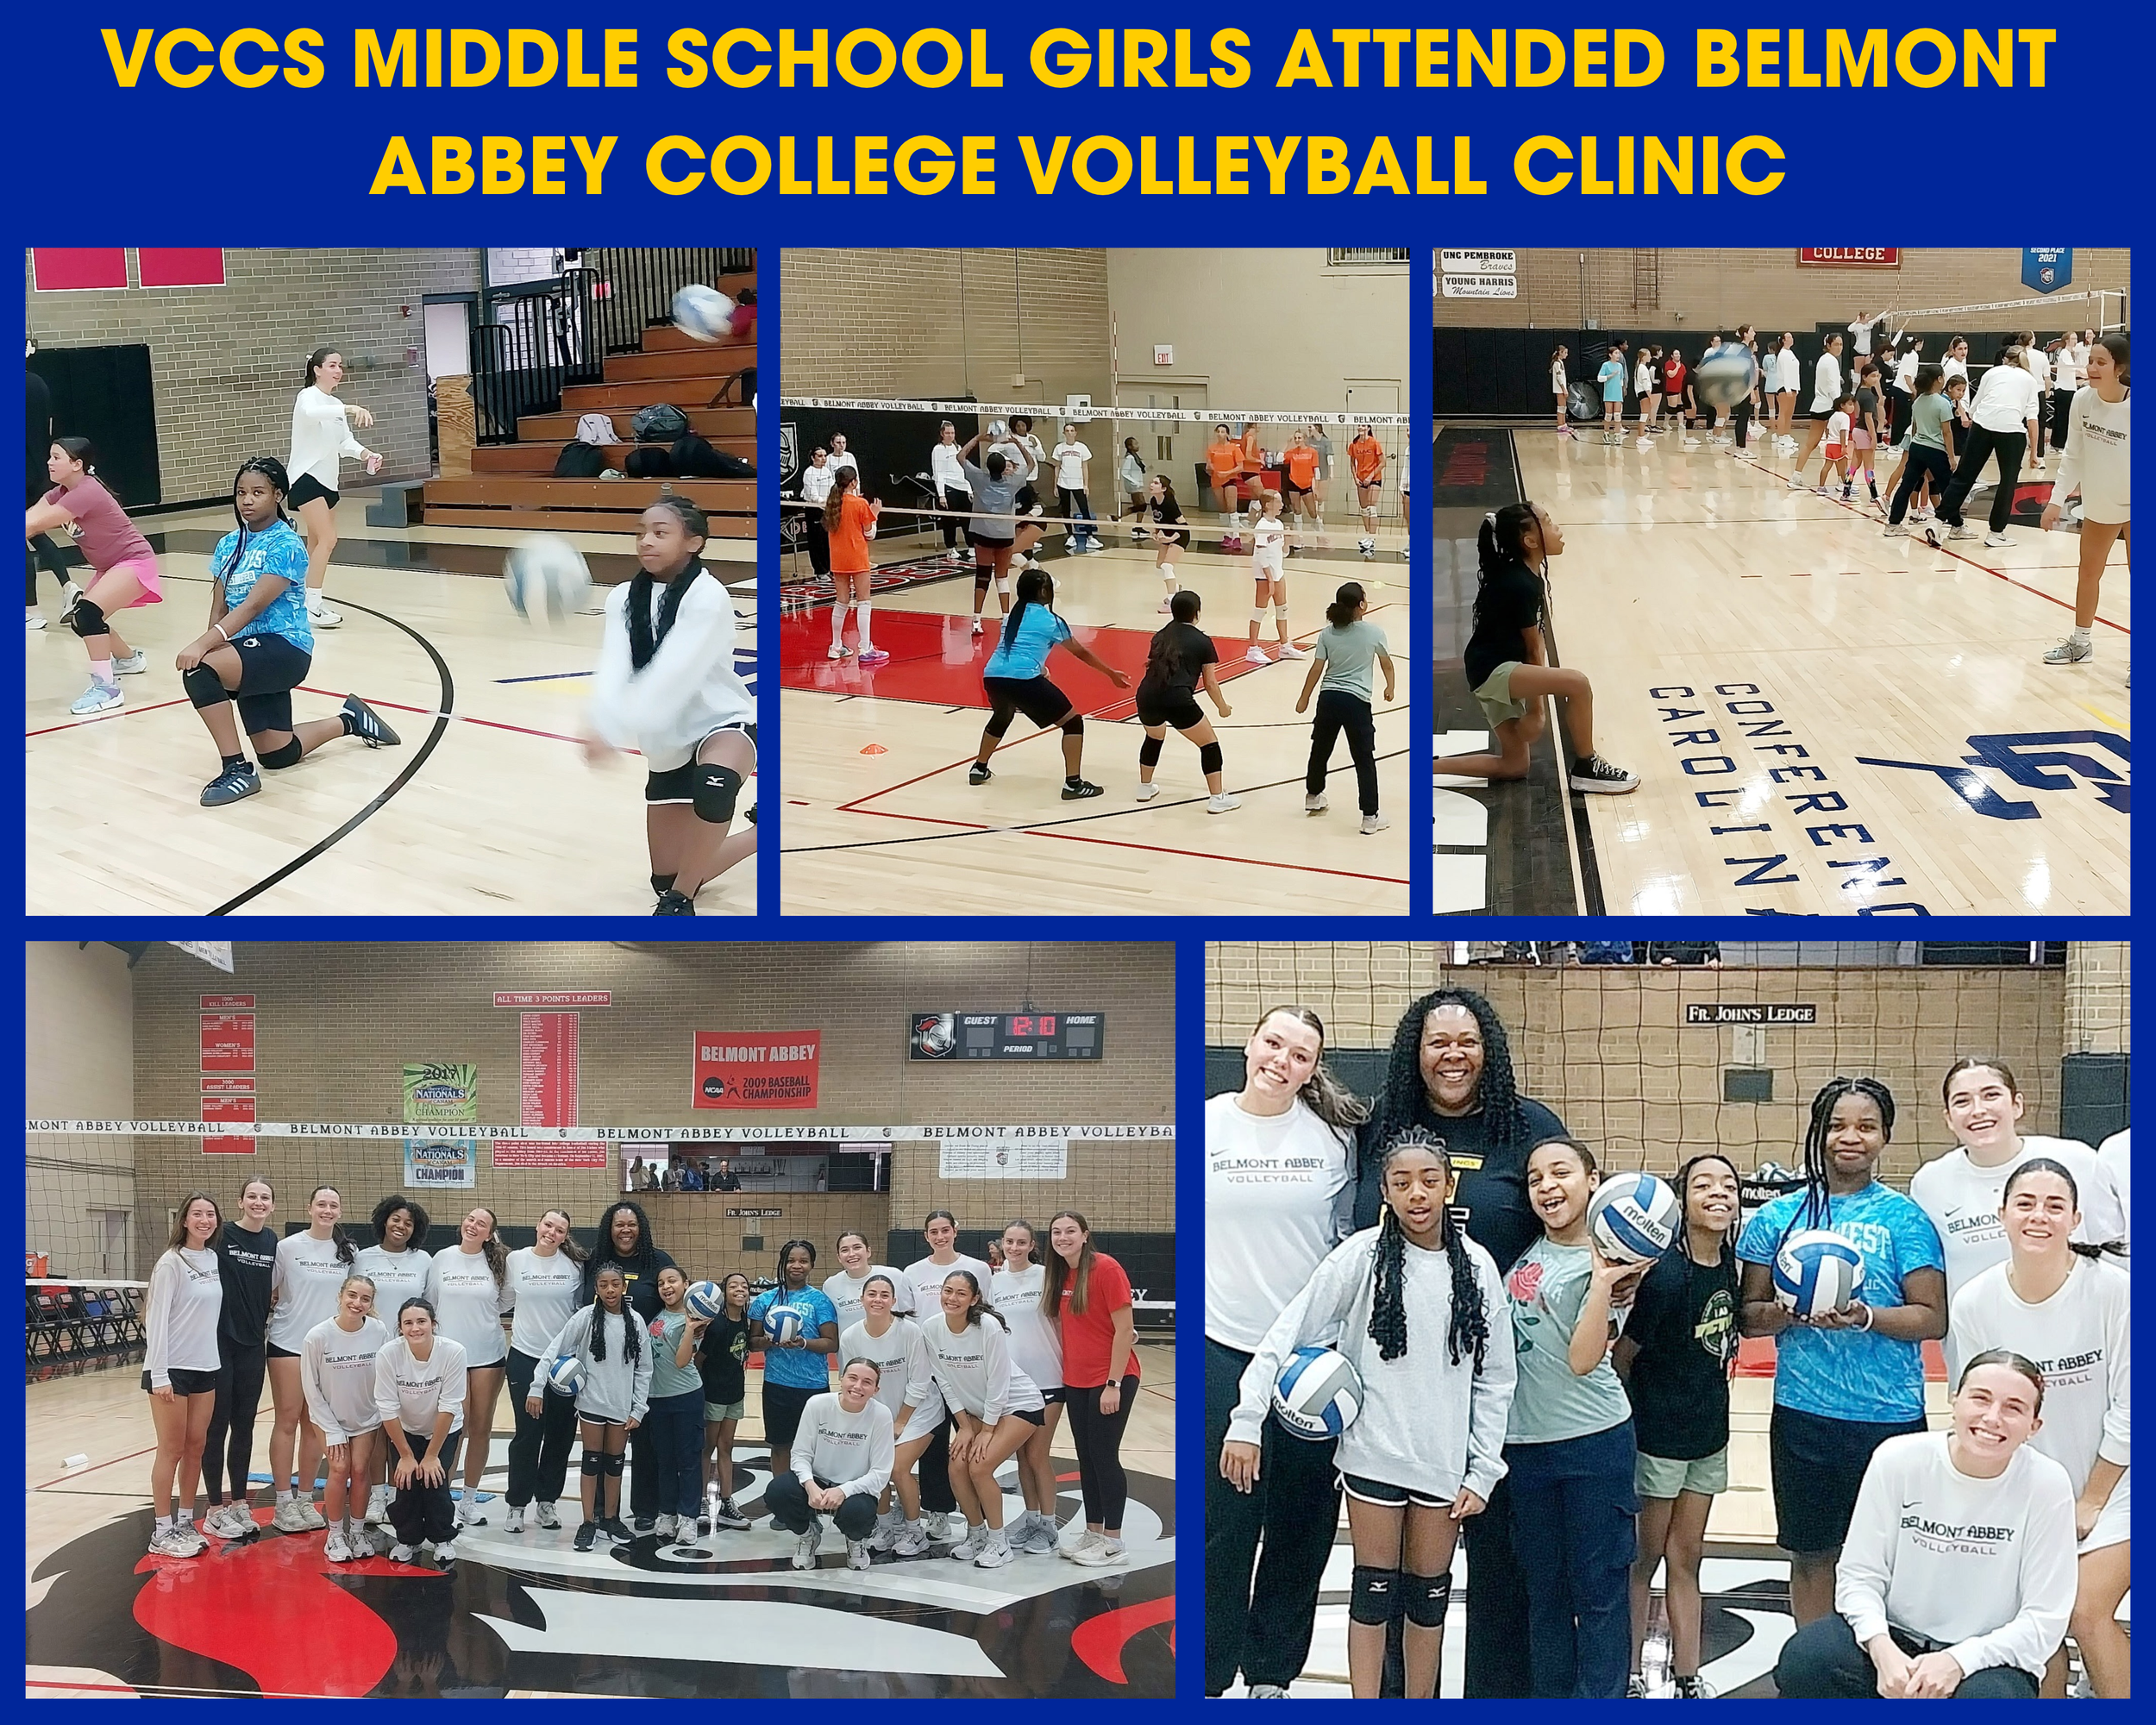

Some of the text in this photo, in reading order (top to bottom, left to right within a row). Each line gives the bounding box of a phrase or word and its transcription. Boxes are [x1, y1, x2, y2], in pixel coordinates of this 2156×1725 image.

[1814, 248, 1885, 260] COLLEGE
[2038, 254, 2057, 262] 2021
[1480, 260, 1513, 270] Braves
[1479, 278, 1514, 286] HARRIS
[1452, 286, 1514, 296] Mountain Lions
[1158, 354, 1169, 363] EXIT
[980, 405, 1004, 414] ABBEY
[1005, 407, 1051, 416] VOLLEYBALL
[1073, 409, 1187, 420] BELMONT ABBEY VOLLEYBALL
[1208, 412, 1329, 423] BELMONT ABBEY VOLLEYBALL
[1353, 416, 1393, 424] BELMONT
[1649, 687, 1820, 916] CAROLIN
[964, 1016, 998, 1025] GUEST
[701, 1044, 816, 1061] BELMONT ABBEY
[423, 1069, 457, 1080] 2017
[743, 1076, 810, 1088] 2009 BASEBALL
[416, 1089, 464, 1099] NATIONALS
[743, 1087, 812, 1099] CHAMPIONSHIP
[76, 1121, 122, 1131] ABBEY
[131, 1122, 225, 1132] VOLLEYBALL
[291, 1125, 529, 1138] BELMONT ABBEY VOLLEYBALL
[924, 1126, 1007, 1137] BELMONT
[1014, 1126, 1071, 1137] ABBEY
[597, 1127, 849, 1138] BELMONT ABBEY VOLLEYBALL
[416, 1149, 464, 1159] NATIONALS
[1213, 1157, 1325, 1173] BELMONT ABBEY
[416, 1168, 464, 1180] CHAMPION
[1226, 1175, 1313, 1183] VOLLEYBALL
[1742, 1186, 1781, 1201] molten
[1623, 1205, 1666, 1244] molten
[229, 1249, 259, 1259] BELMONT
[236, 1258, 271, 1268] VOLLEYBALL
[698, 1294, 719, 1311] molten
[994, 1293, 1019, 1304] BELMONT
[999, 1299, 1035, 1308] VOLLEYBALL
[325, 1354, 357, 1363] BELMONT
[886, 1357, 906, 1366] ABBEY
[2058, 1349, 2103, 1371] ABBEY
[397, 1377, 443, 1389] BELMONT ABBEY
[548, 1377, 567, 1392] molten
[401, 1387, 438, 1396] VOLLEYBALL
[1273, 1396, 1314, 1428] molten
[818, 1428, 868, 1440] BELMONT ABBEY
[823, 1437, 861, 1446] VOLLEYBALL
[1901, 1515, 2015, 1542] BELMONT ABBEY
[1912, 1535, 1997, 1556] VOLLEYBALL
